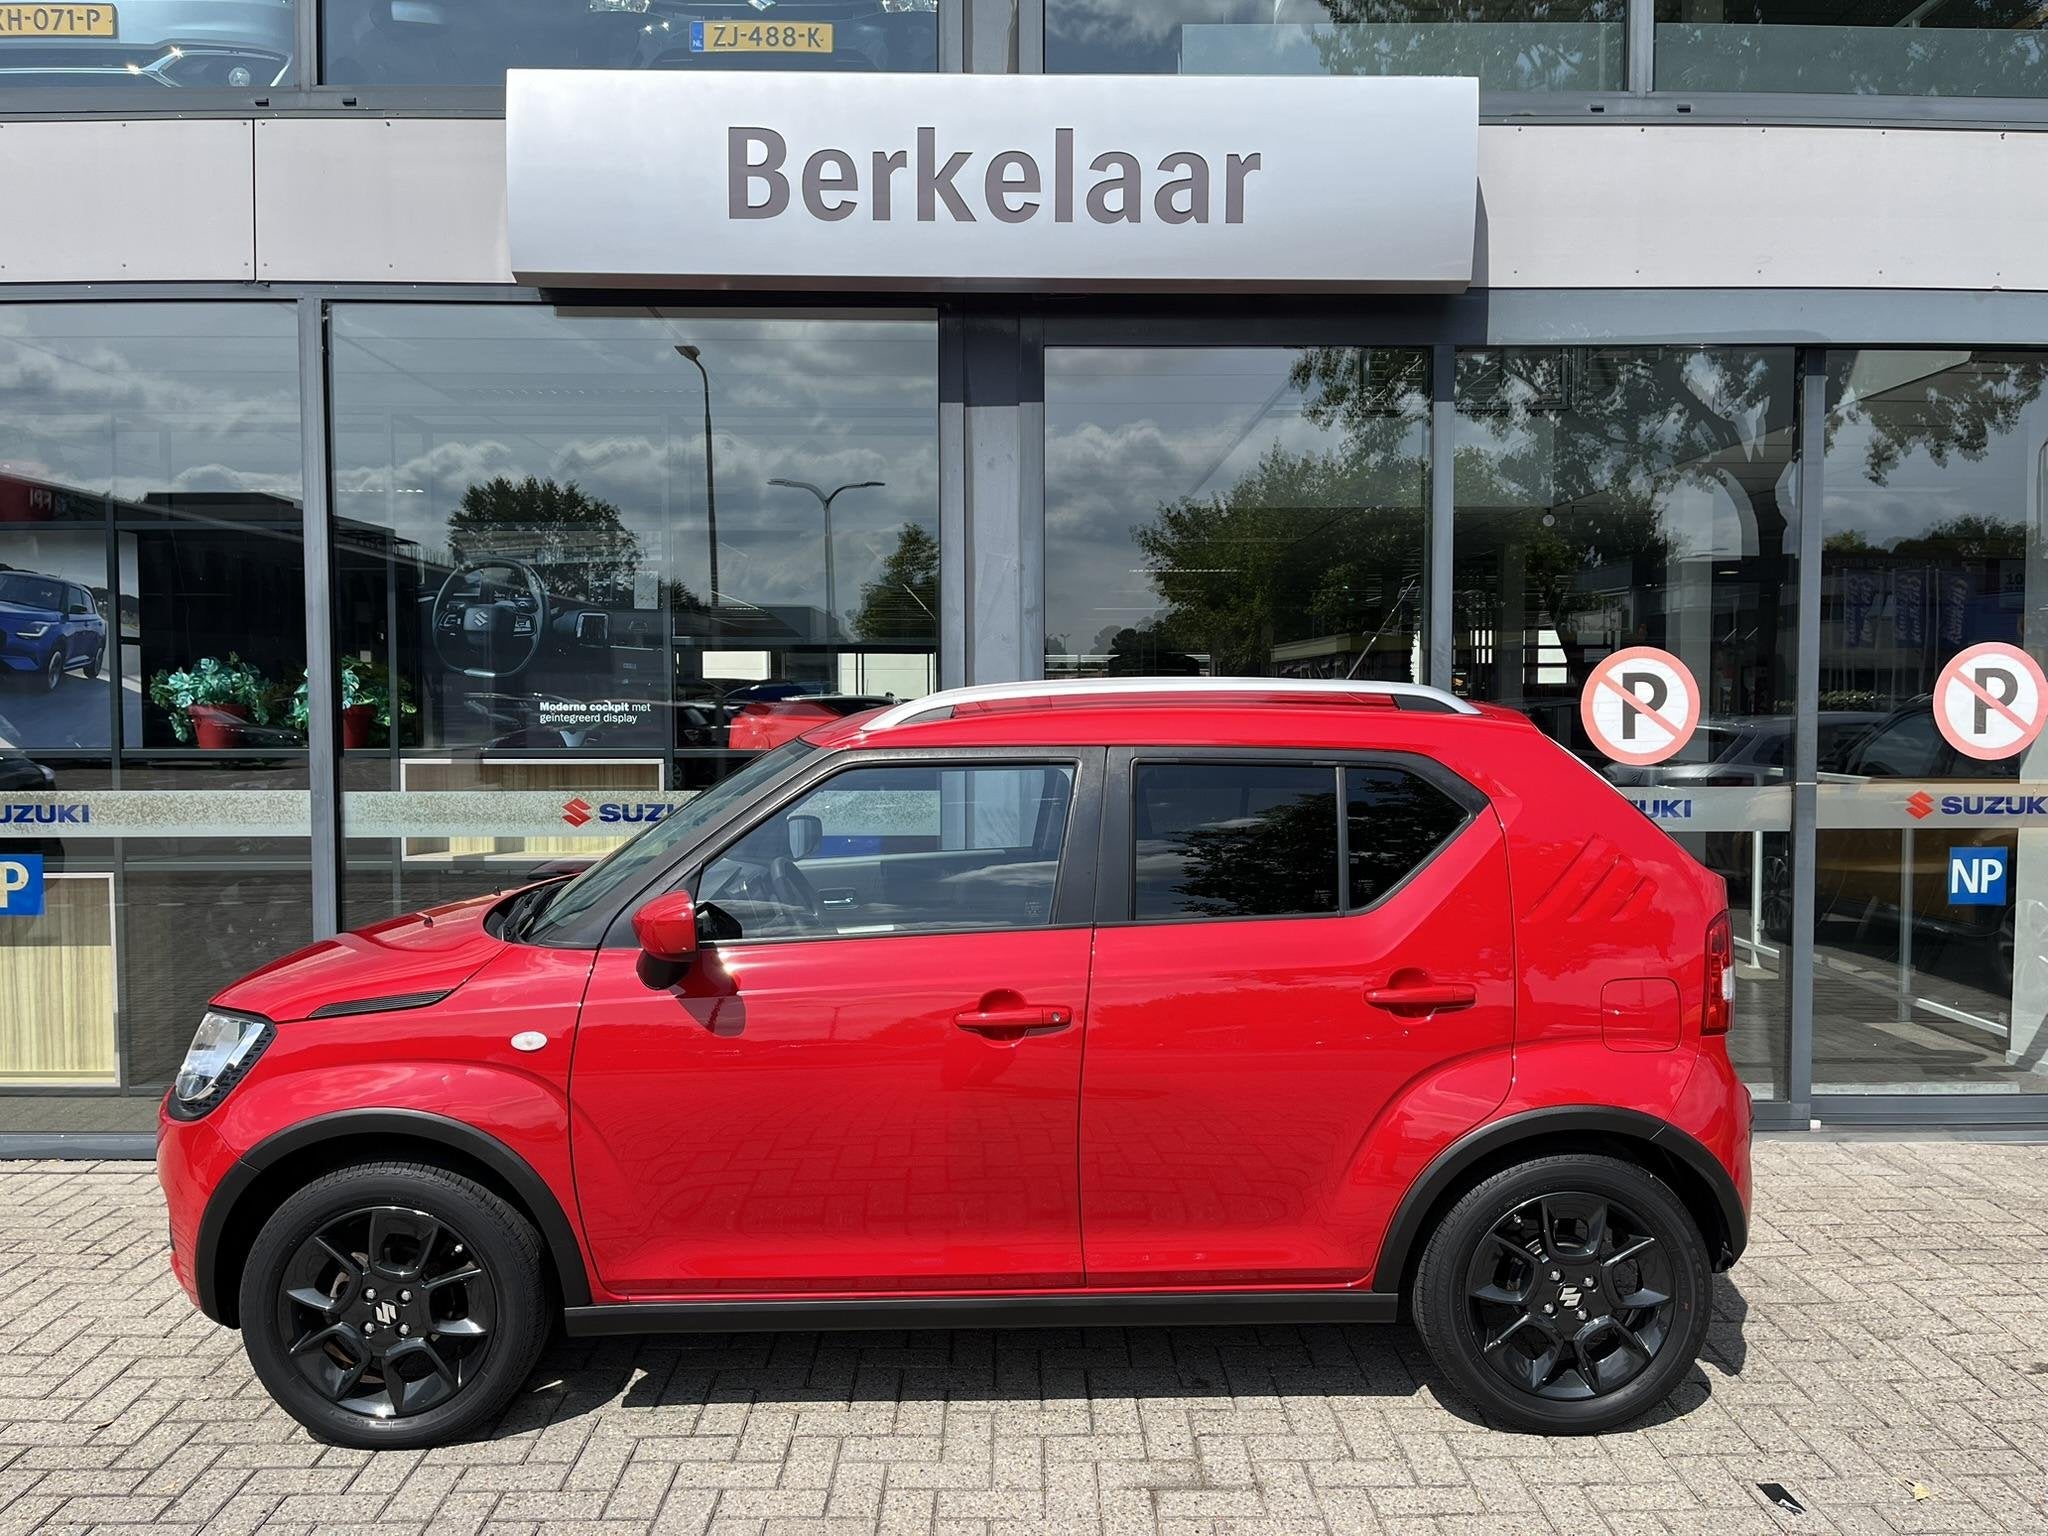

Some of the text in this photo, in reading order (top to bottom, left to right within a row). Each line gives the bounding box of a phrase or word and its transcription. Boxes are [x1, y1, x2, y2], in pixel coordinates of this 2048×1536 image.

[712, 26, 822, 48] ZJ-488-K
[728, 126, 1262, 224] Berkelaar
[540, 701, 651, 713] Moderne cockpit met
[603, 713, 638, 724] display
[1622, 672, 1668, 739] P
[1974, 668, 2018, 734] P
[1951, 858, 2003, 894] NP
